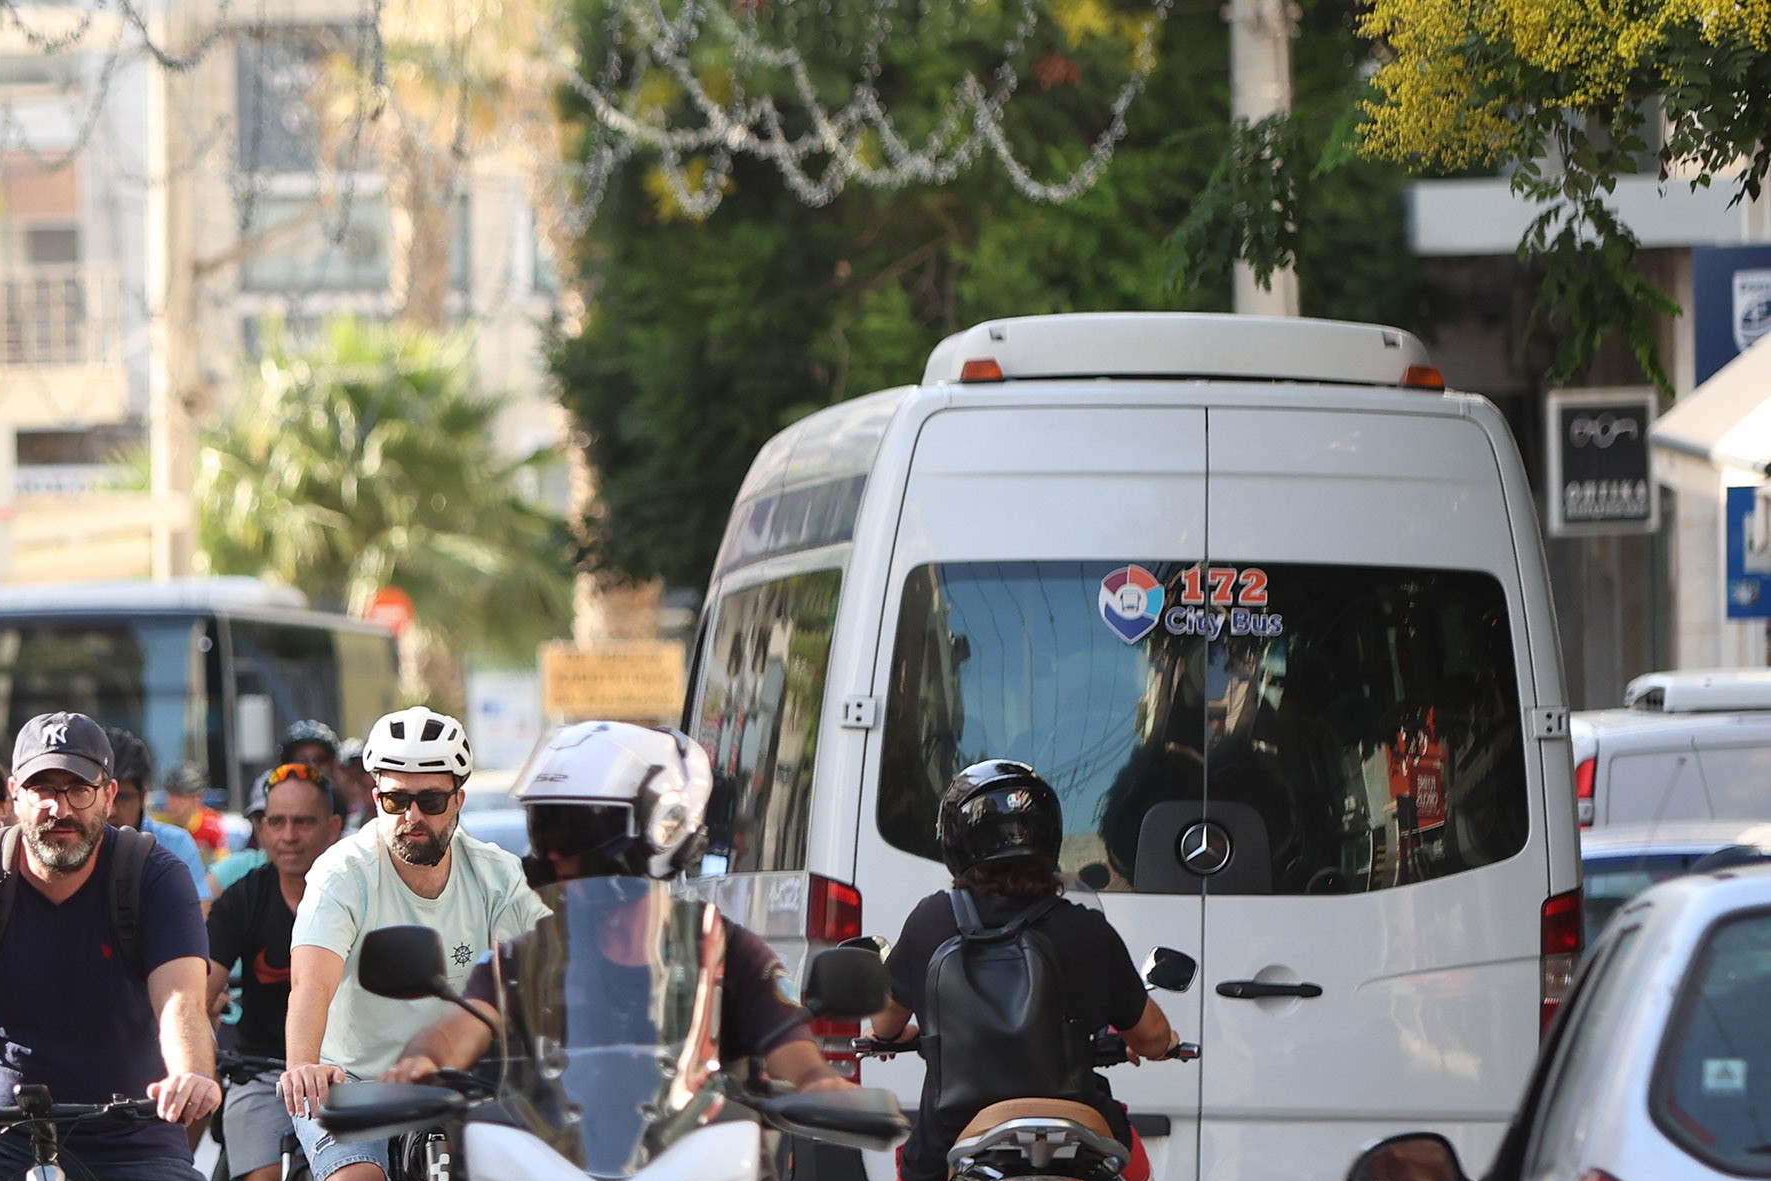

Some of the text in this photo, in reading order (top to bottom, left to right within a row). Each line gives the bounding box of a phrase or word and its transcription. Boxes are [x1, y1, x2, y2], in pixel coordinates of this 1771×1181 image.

[1181, 568, 1268, 605] 172
[1165, 606, 1283, 641] City Bus
